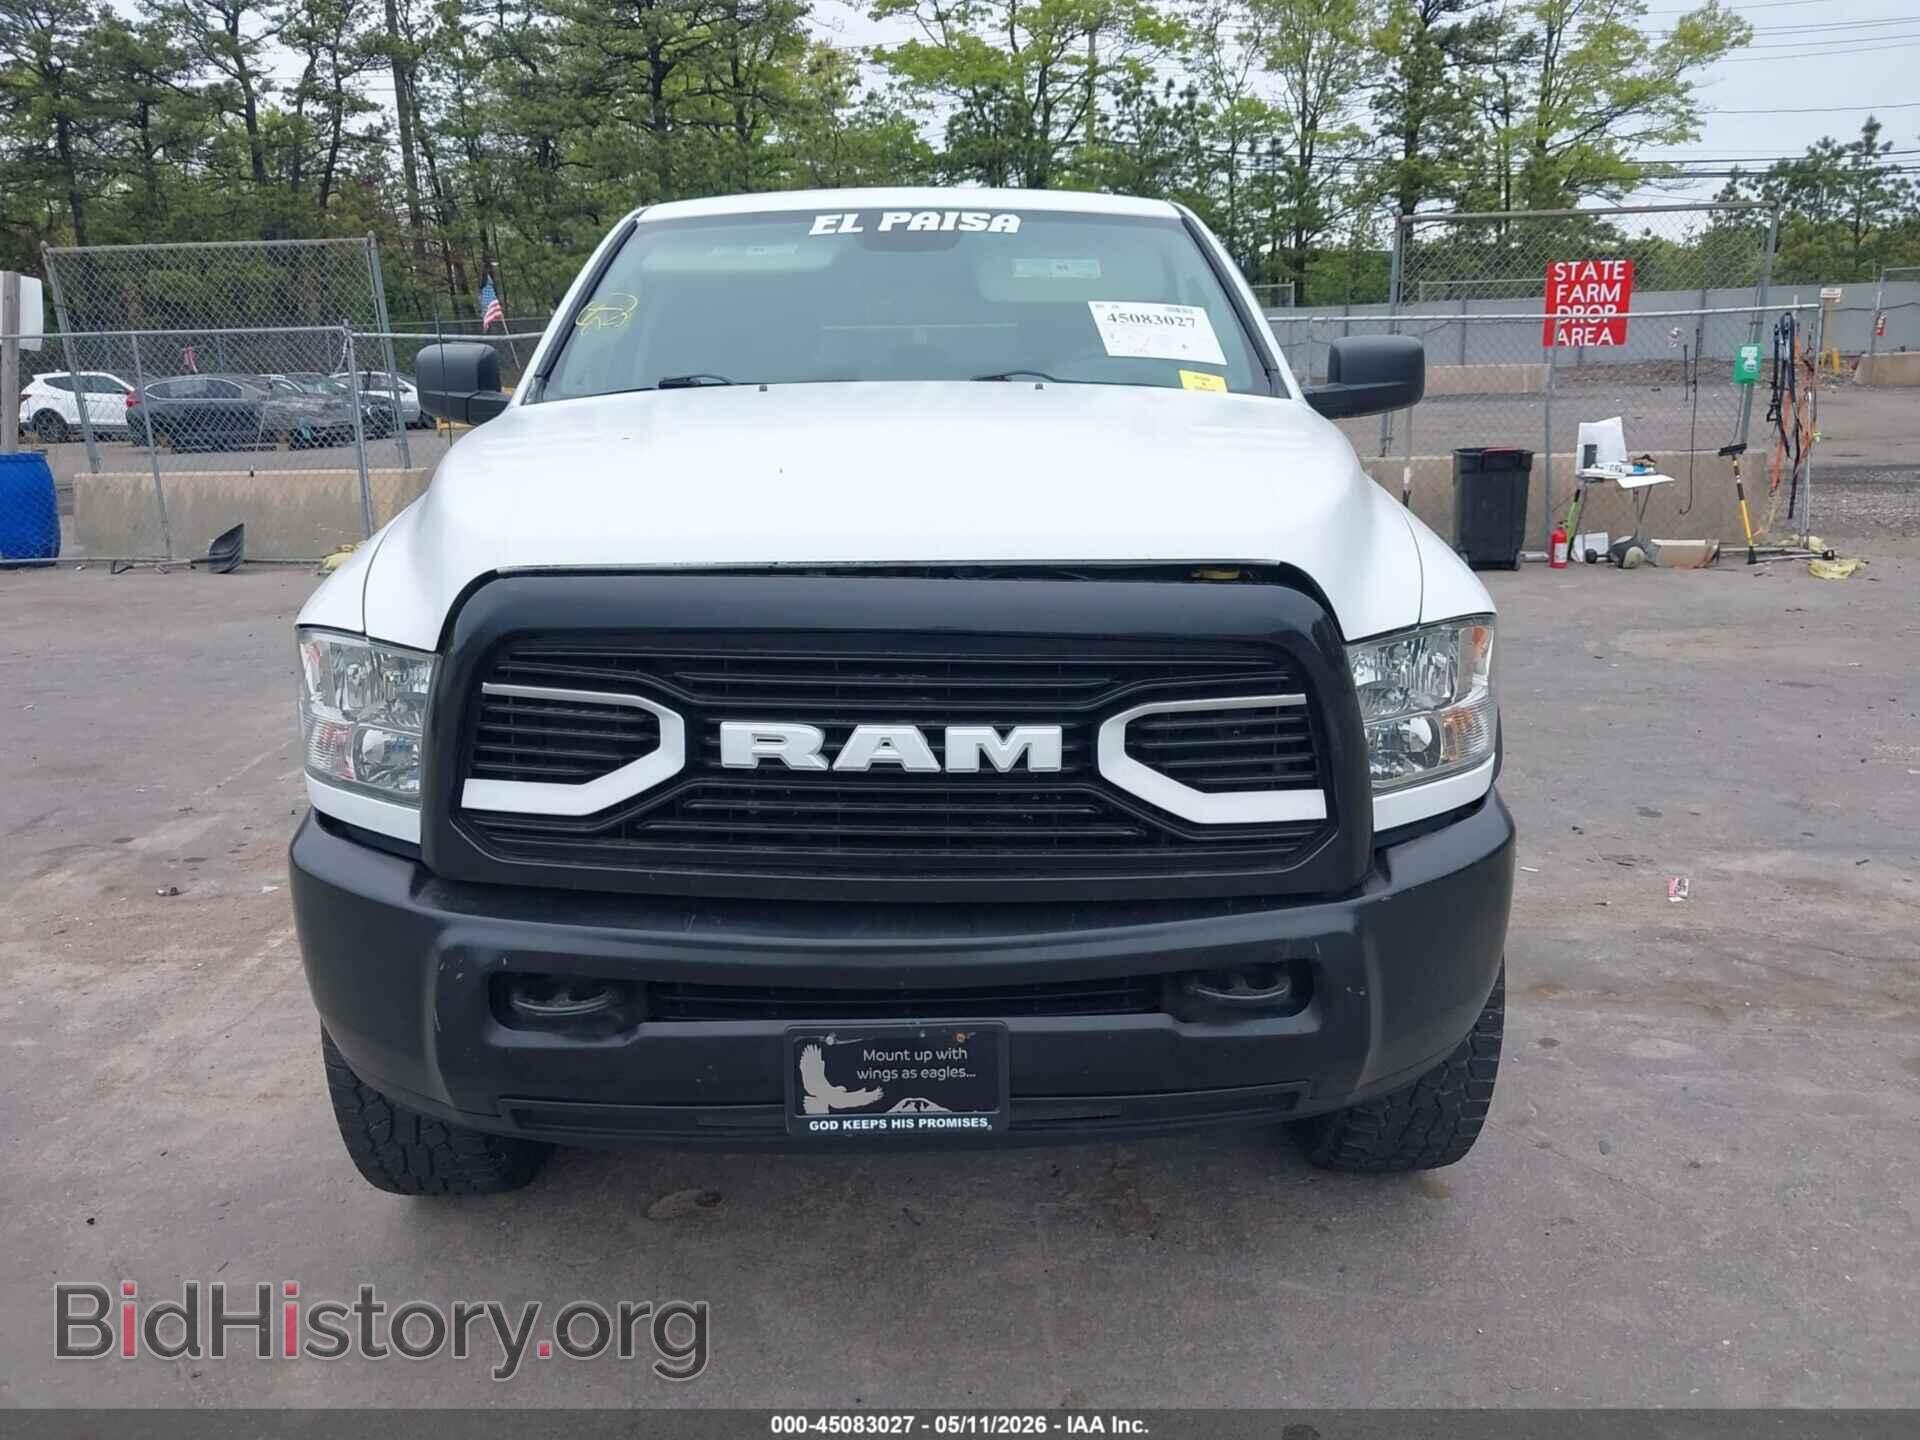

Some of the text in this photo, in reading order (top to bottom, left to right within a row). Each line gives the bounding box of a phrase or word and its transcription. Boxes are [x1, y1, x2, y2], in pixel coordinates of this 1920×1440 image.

[808, 211, 1022, 235] EL PAISA
[1554, 260, 1626, 281] STATE
[1556, 283, 1621, 304] FARM
[1107, 312, 1196, 329] 45083027
[1556, 305, 1617, 324] DROP
[1557, 327, 1614, 347] AREA
[720, 721, 1062, 773] RAM
[863, 1047, 968, 1063] Mount up with
[857, 1065, 976, 1081] wings as eagles...
[809, 1120, 838, 1131] GOD
[843, 1119, 887, 1130] KEEPS
[891, 1118, 915, 1130] HIS
